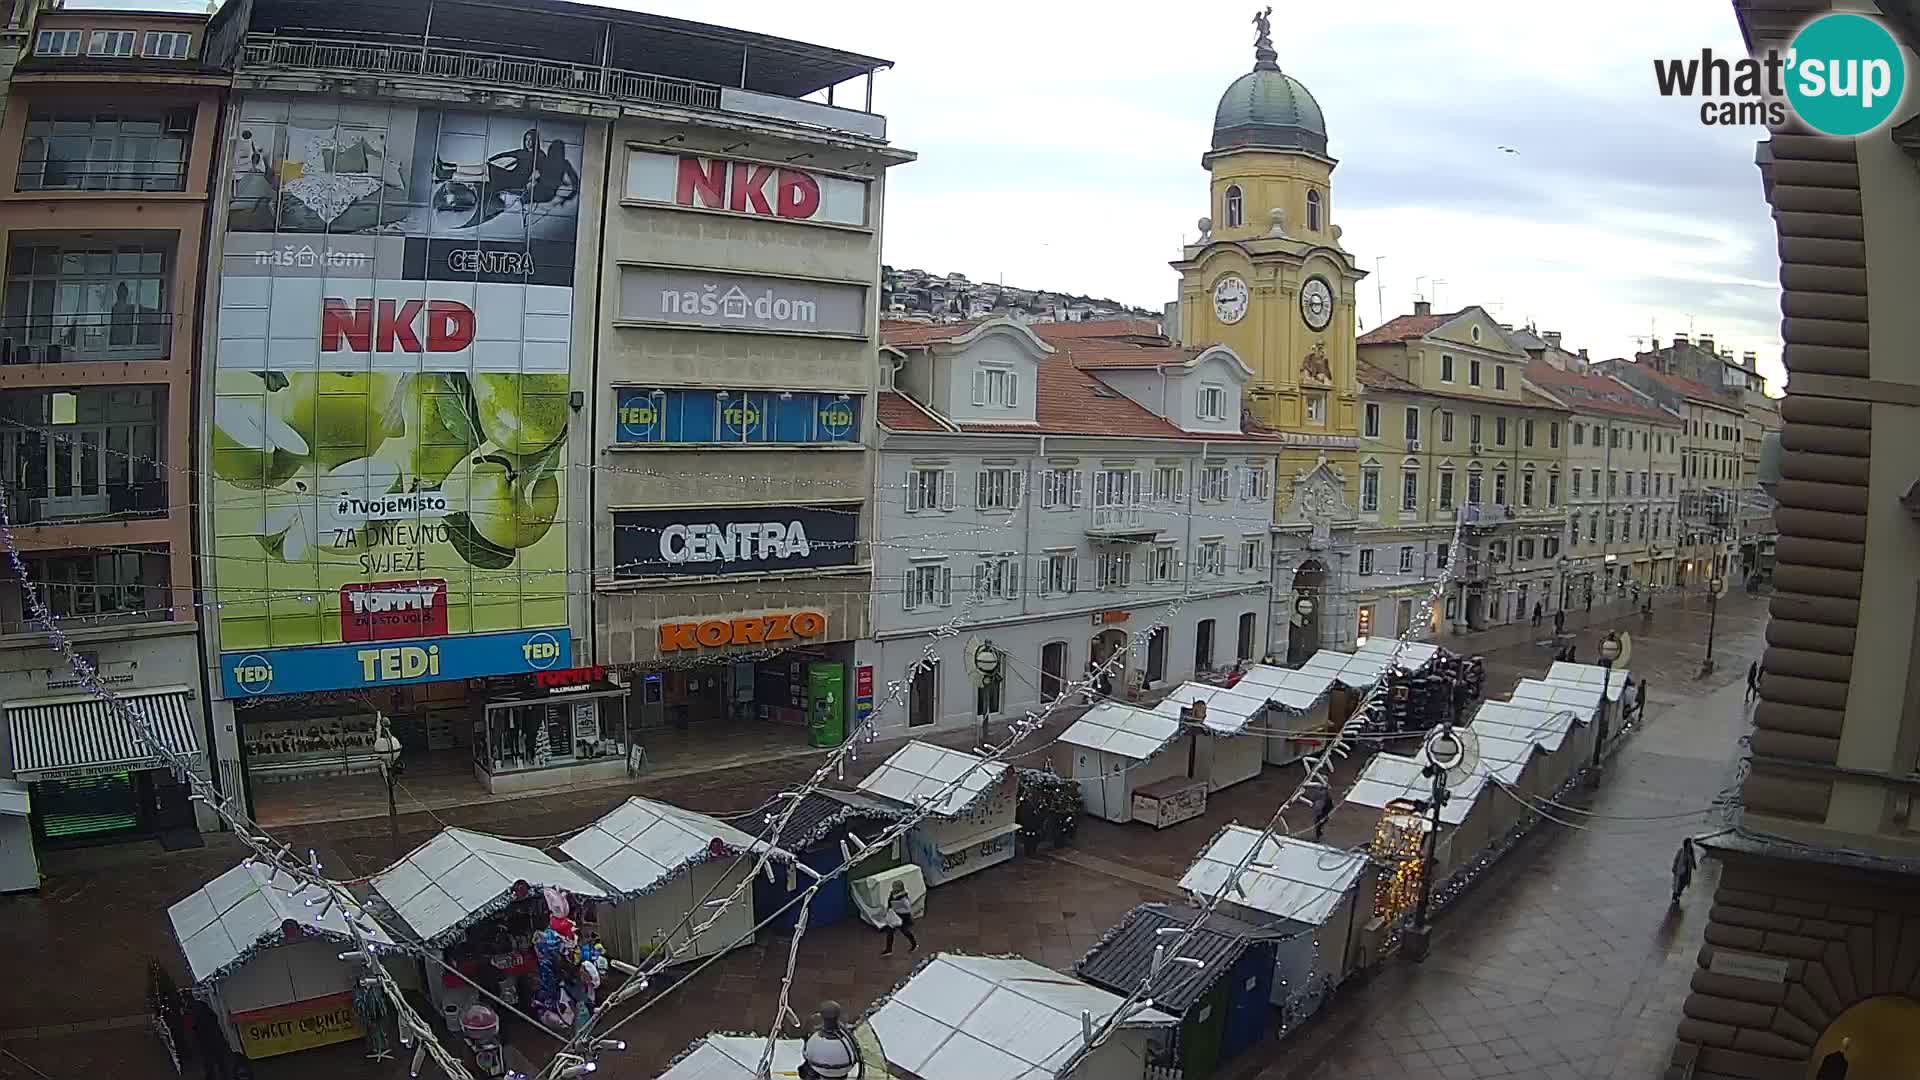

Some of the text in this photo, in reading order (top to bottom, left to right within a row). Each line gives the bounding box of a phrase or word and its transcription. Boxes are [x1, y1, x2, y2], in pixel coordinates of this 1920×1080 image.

[676, 156, 820, 218] NKD
[255, 245, 365, 267] naš dom
[448, 250, 535, 274] CENTRA
[662, 284, 816, 322] naš dom
[321, 297, 476, 352] NKD
[338, 497, 445, 515] #TvojeMisto
[334, 524, 450, 548] ZA DNEVNO
[660, 521, 810, 562] CENTRA
[360, 547, 425, 574] SVJEŽE
[349, 586, 439, 613] TOMMY
[660, 612, 826, 652] KORZO
[357, 645, 440, 681] TEDi
[522, 641, 560, 660] TEDi
[234, 665, 273, 683] TEDi
